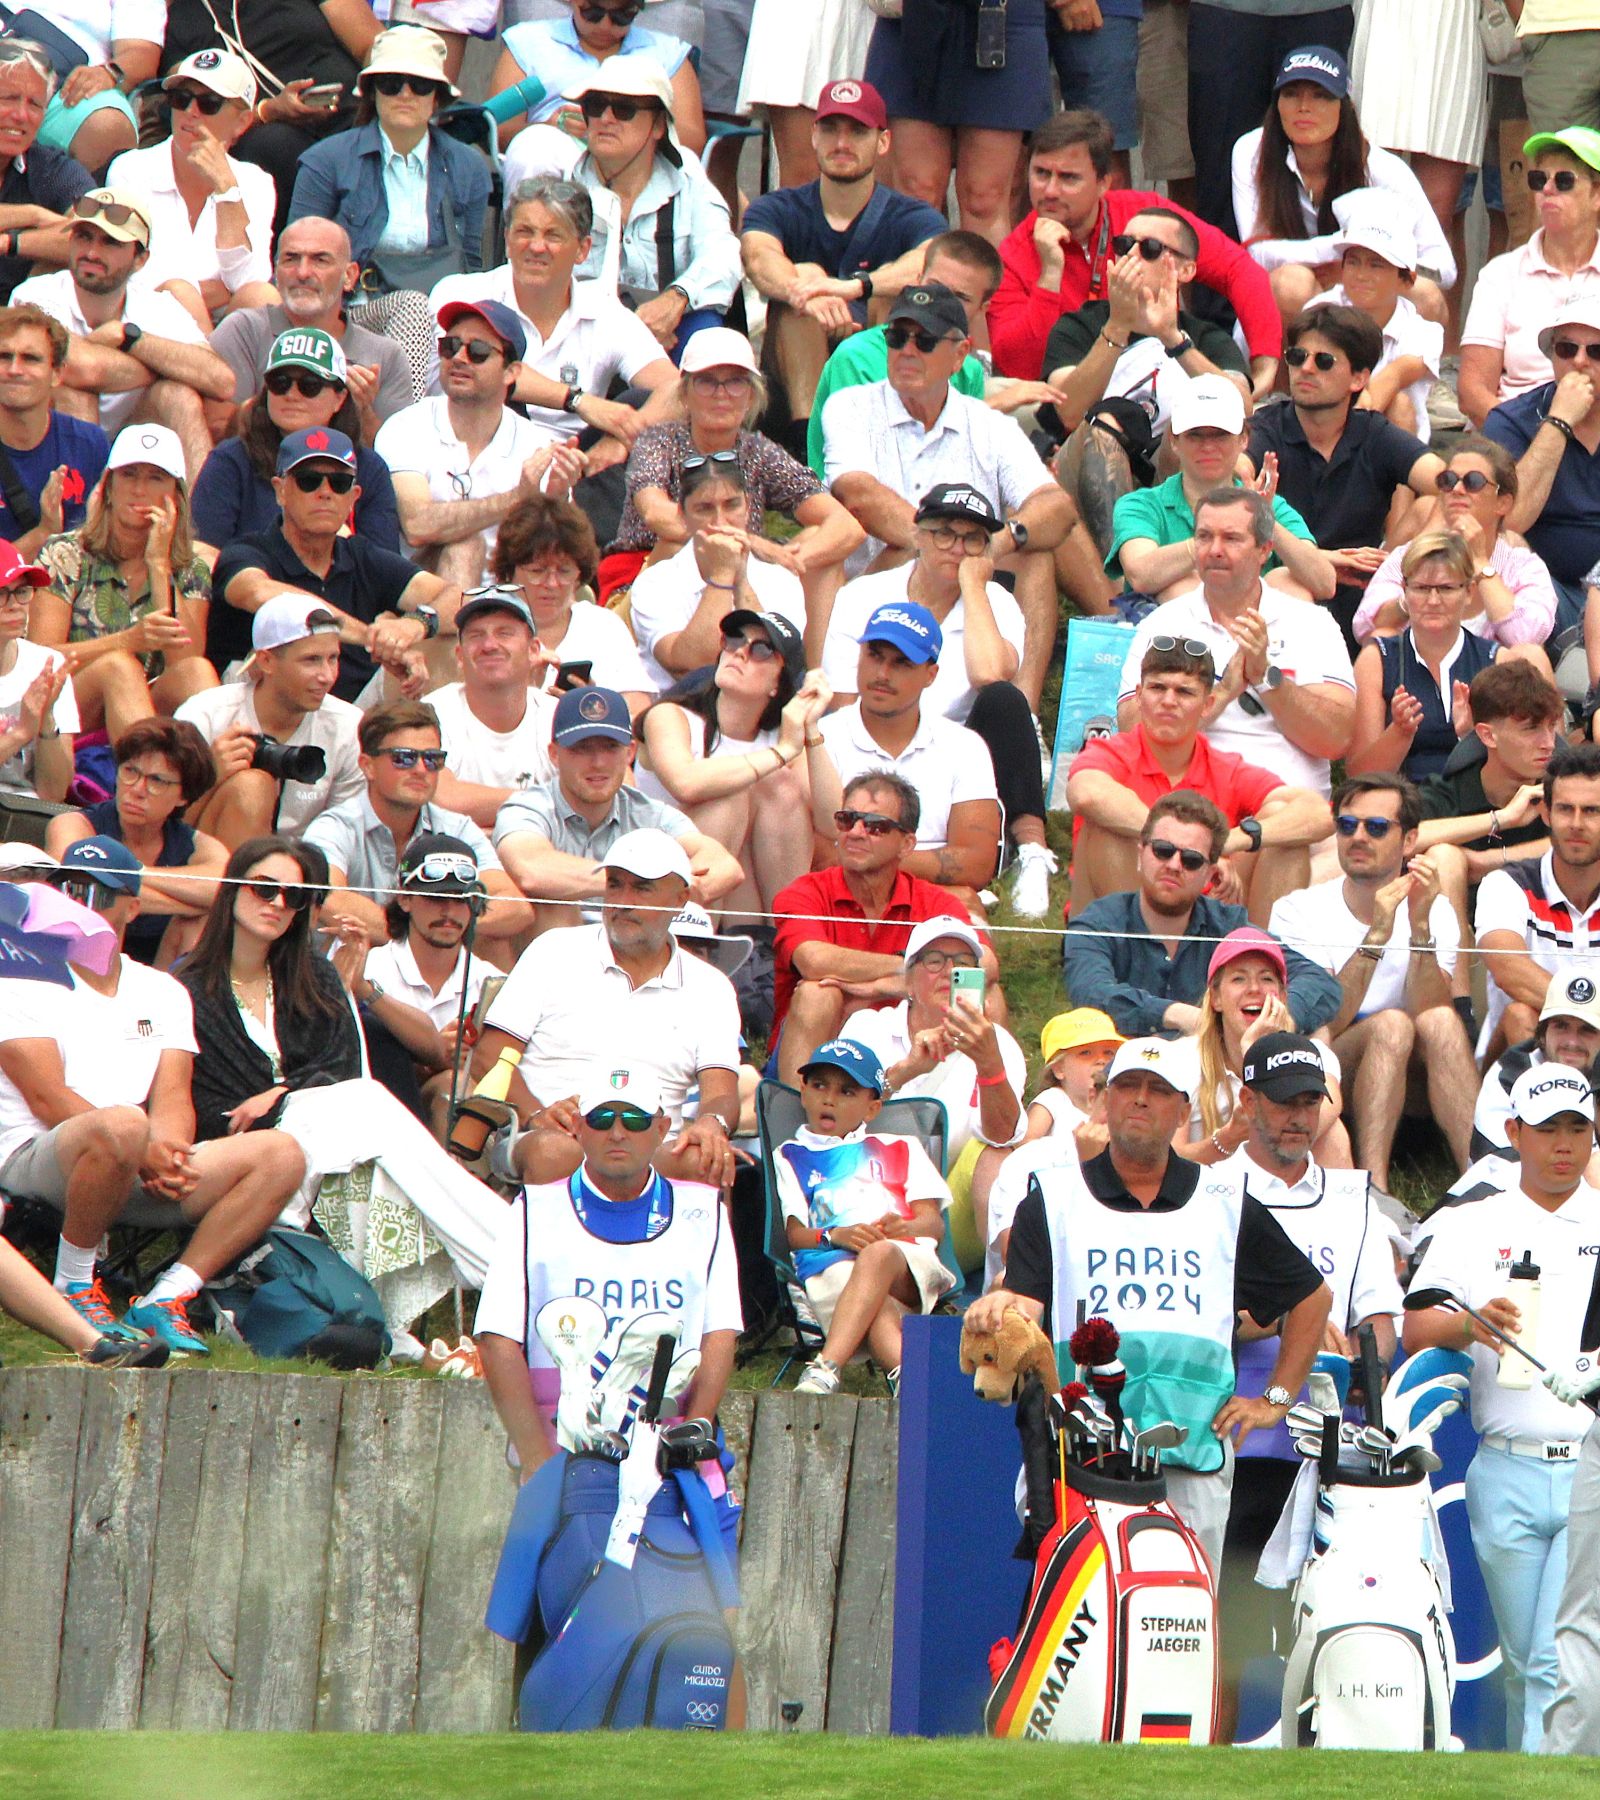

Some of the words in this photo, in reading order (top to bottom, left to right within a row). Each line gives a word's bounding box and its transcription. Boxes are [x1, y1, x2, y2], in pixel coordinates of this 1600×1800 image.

[280, 335, 329, 360] GOLF
[871, 608, 930, 638] Titleist
[820, 1040, 864, 1062] Callaway
[1529, 1078, 1592, 1100] KOREA
[1547, 1446, 1570, 1459] WAAC
[1141, 1616, 1207, 1633] STEPHAN
[1146, 1638, 1201, 1653] JAEGER
[692, 1664, 721, 1675] GUIDO
[684, 1675, 726, 1688] MIGLIOZZI
[1337, 1683, 1346, 1698] J.
[1352, 1684, 1369, 1698] H.
[1375, 1683, 1403, 1698] Kim
